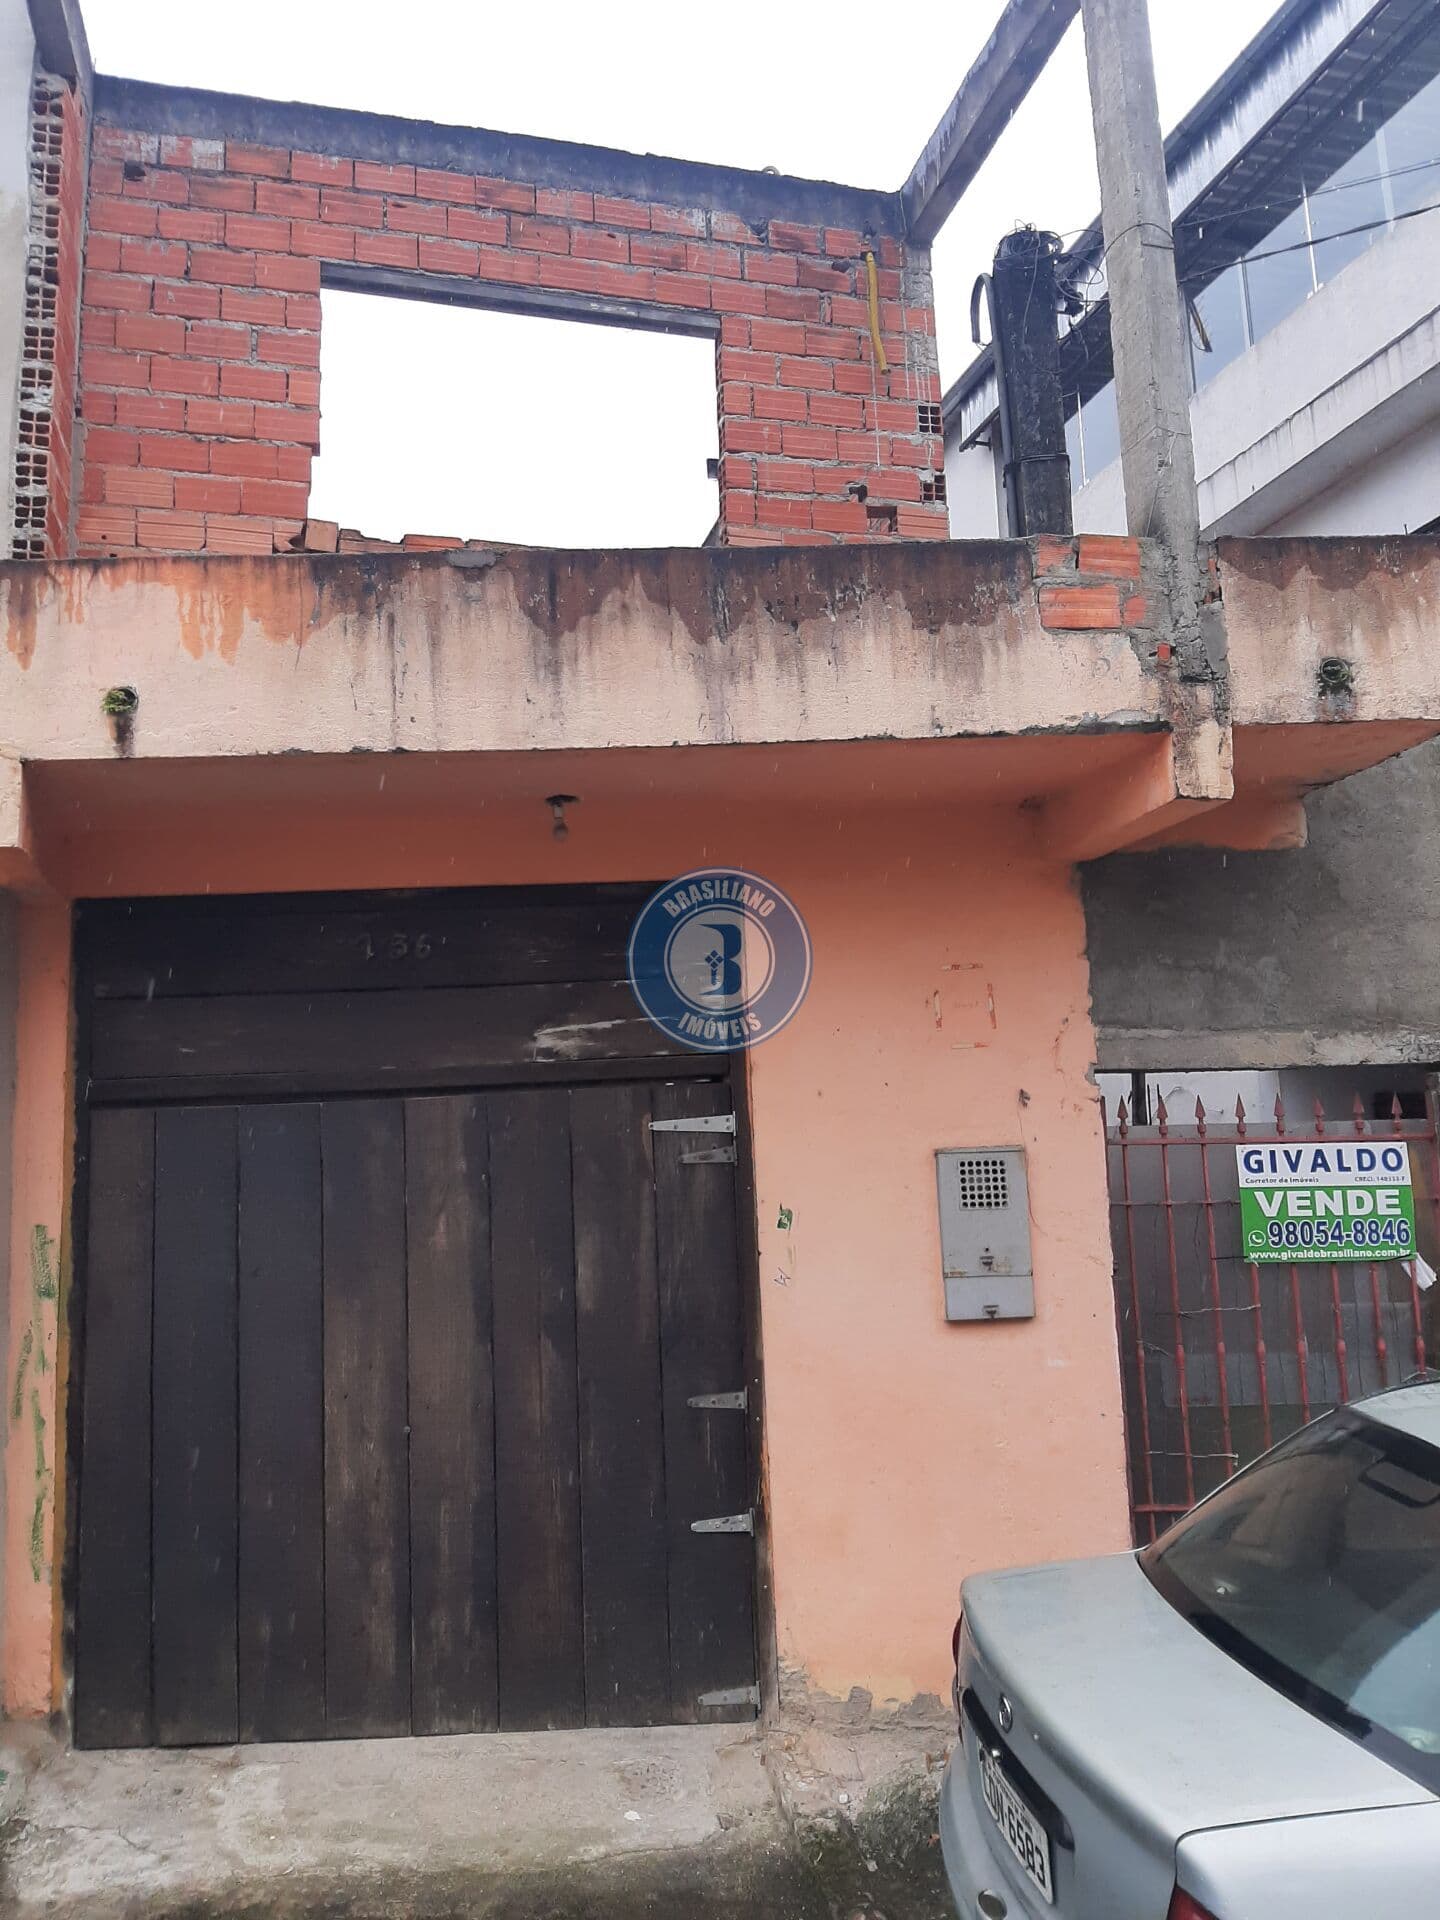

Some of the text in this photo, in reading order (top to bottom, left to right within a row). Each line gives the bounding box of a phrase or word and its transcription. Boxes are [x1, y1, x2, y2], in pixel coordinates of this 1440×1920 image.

[1243, 1148, 1403, 1174] GIVALDO
[1254, 1189, 1401, 1217] VENDE
[1268, 1219, 1411, 1247] 98054-8846
[1250, 1249, 1411, 1260] www.givaldobrasiliano.com.br
